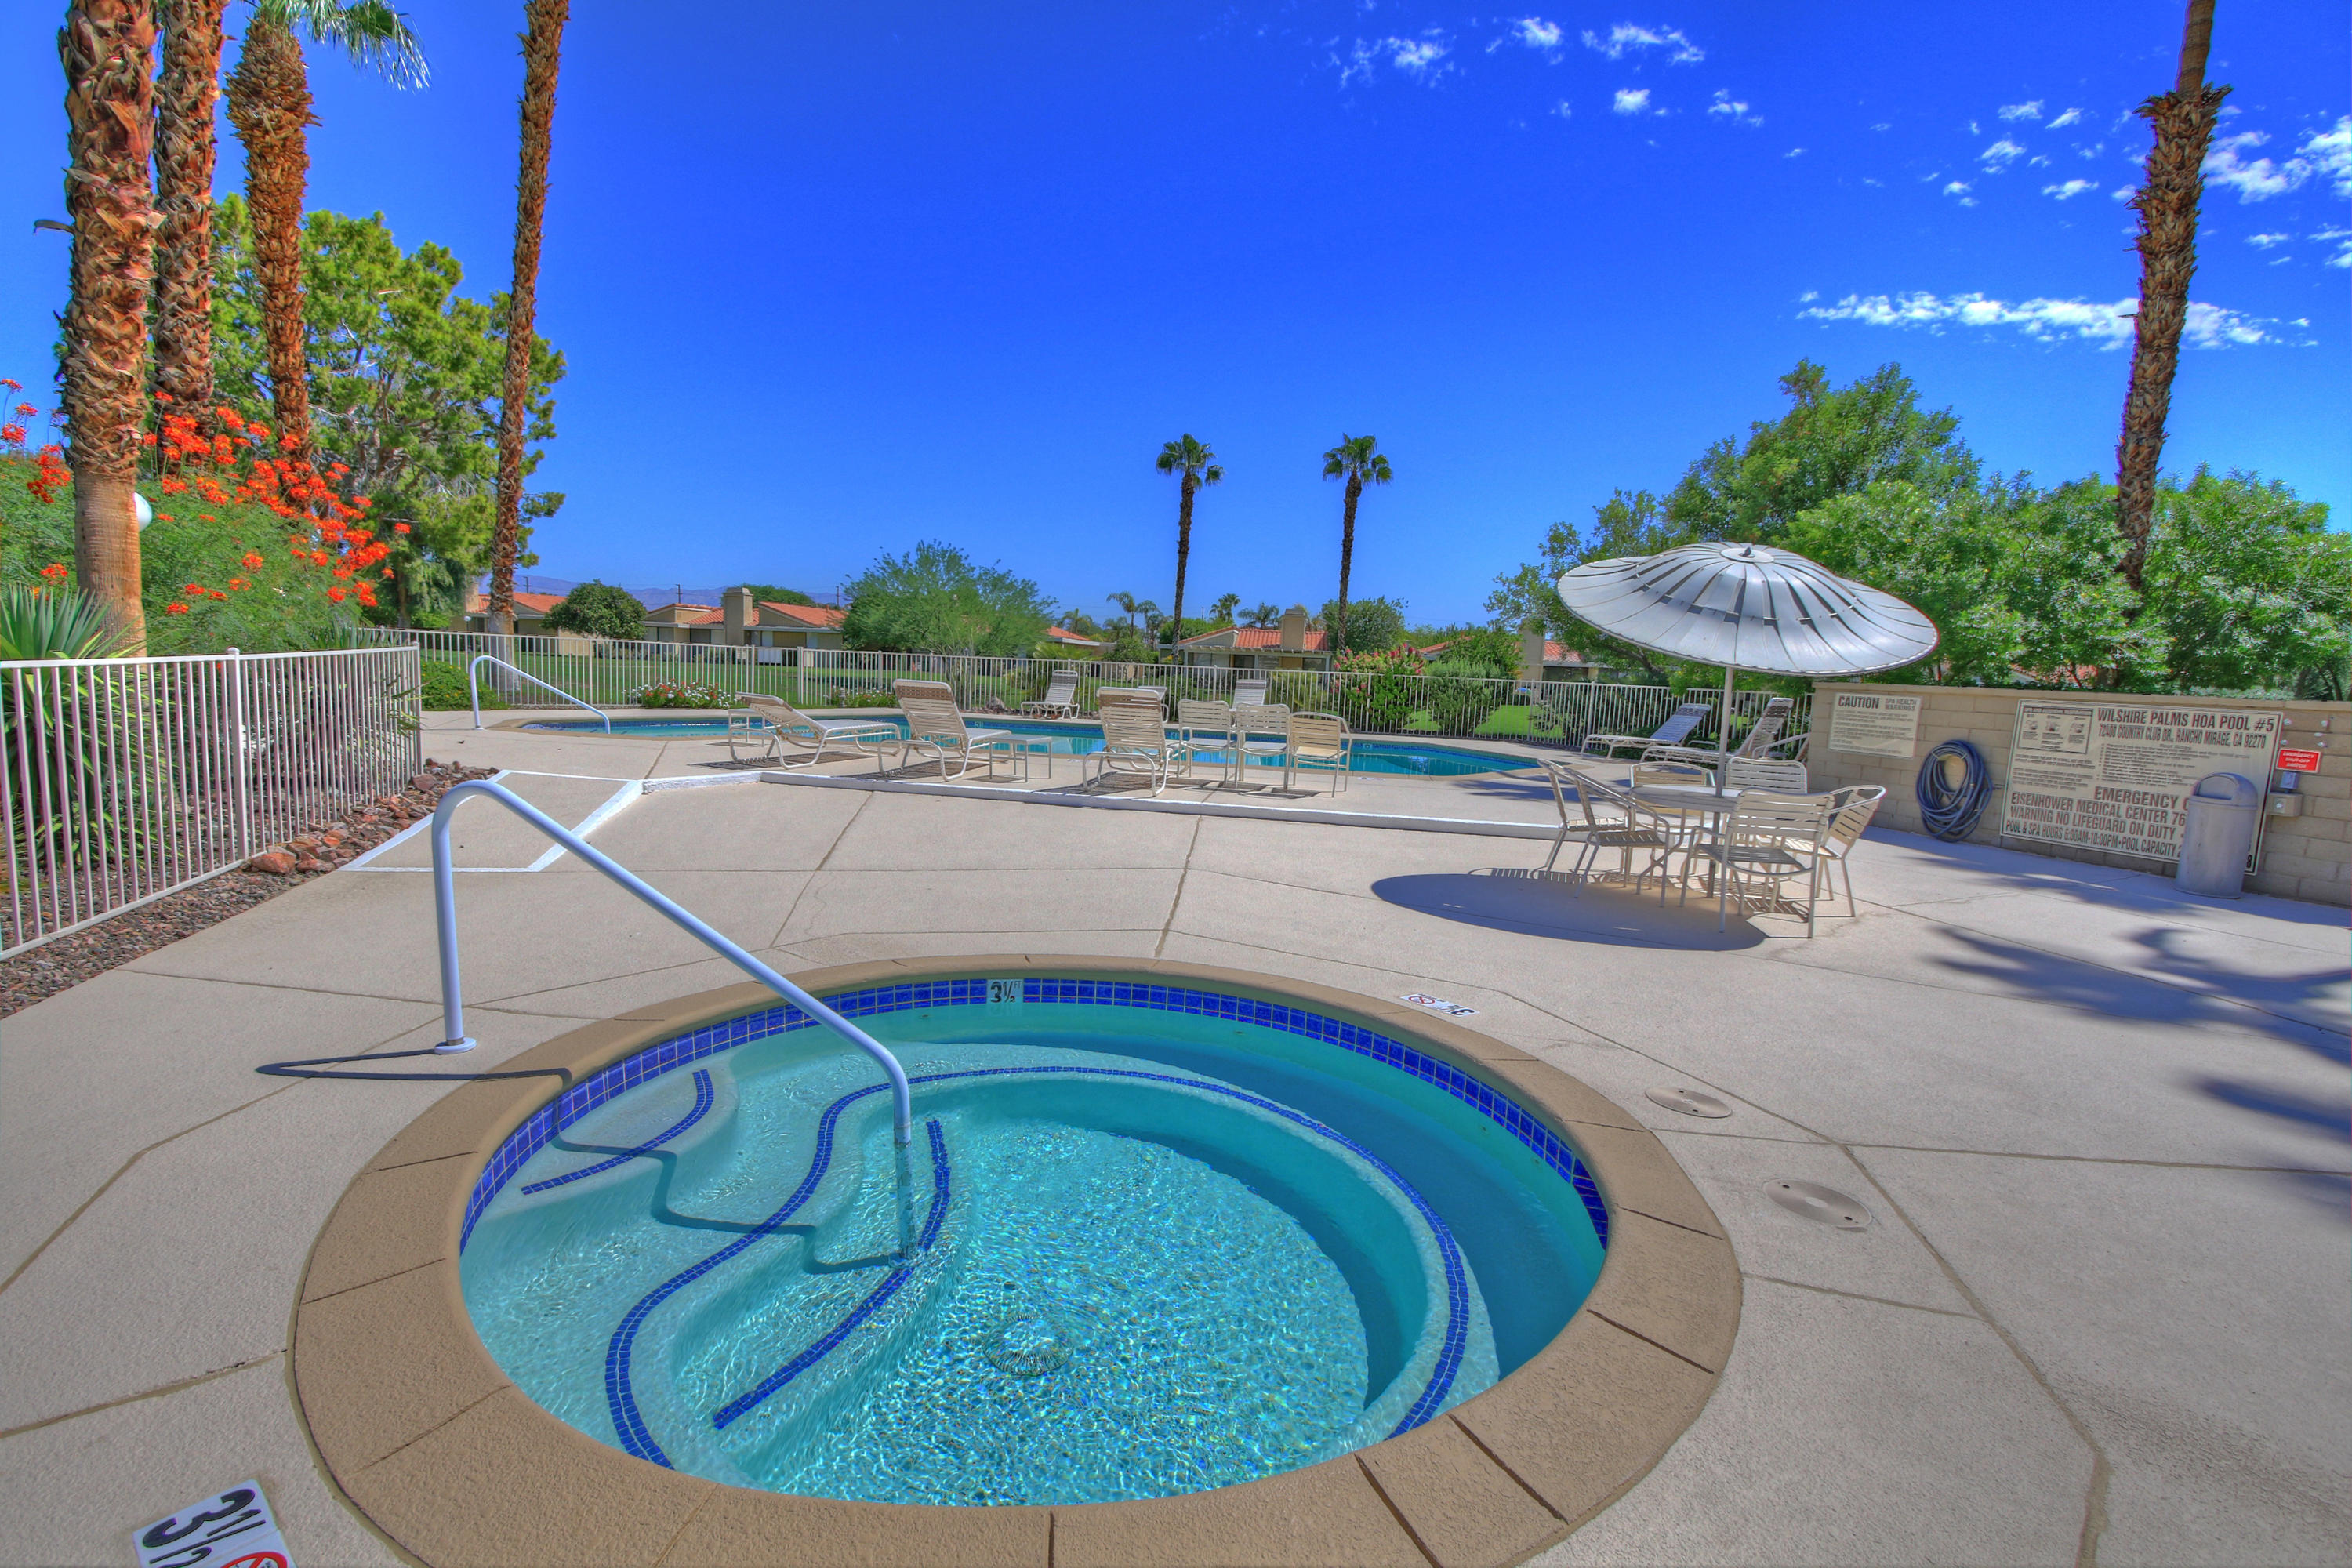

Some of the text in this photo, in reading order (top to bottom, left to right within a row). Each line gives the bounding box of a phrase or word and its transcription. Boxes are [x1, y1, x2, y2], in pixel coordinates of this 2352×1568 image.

[1838, 695, 1880, 709] CAUTION
[2097, 708, 2147, 724] WILSHIRE
[2150, 712, 2189, 727] PALMS
[2191, 713, 2216, 728] HOA
[2220, 715, 2250, 731] POOL
[2254, 717, 2275, 732] #5
[2117, 724, 2145, 740] COUNTRY
[2145, 726, 2161, 741] CLUB
[2176, 728, 2203, 744] RANCHO
[2233, 732, 2242, 747] CA
[2244, 733, 2267, 749] 92270
[2011, 792, 2074, 811] EISENHOWER
[2076, 799, 2122, 818] MEDICAL
[2125, 805, 2169, 824] CENTER
[2095, 786, 2180, 810] EMERGENCY
[2010, 806, 2176, 840] WARNING NO LIFEGUARD ON DUTY
[2005, 819, 2021, 833] POOL
[2022, 824, 2027, 833] &
[2028, 822, 2041, 836] SPA
[2042, 824, 2063, 840] HOURS
[2141, 840, 2177, 857] CAPACITY
